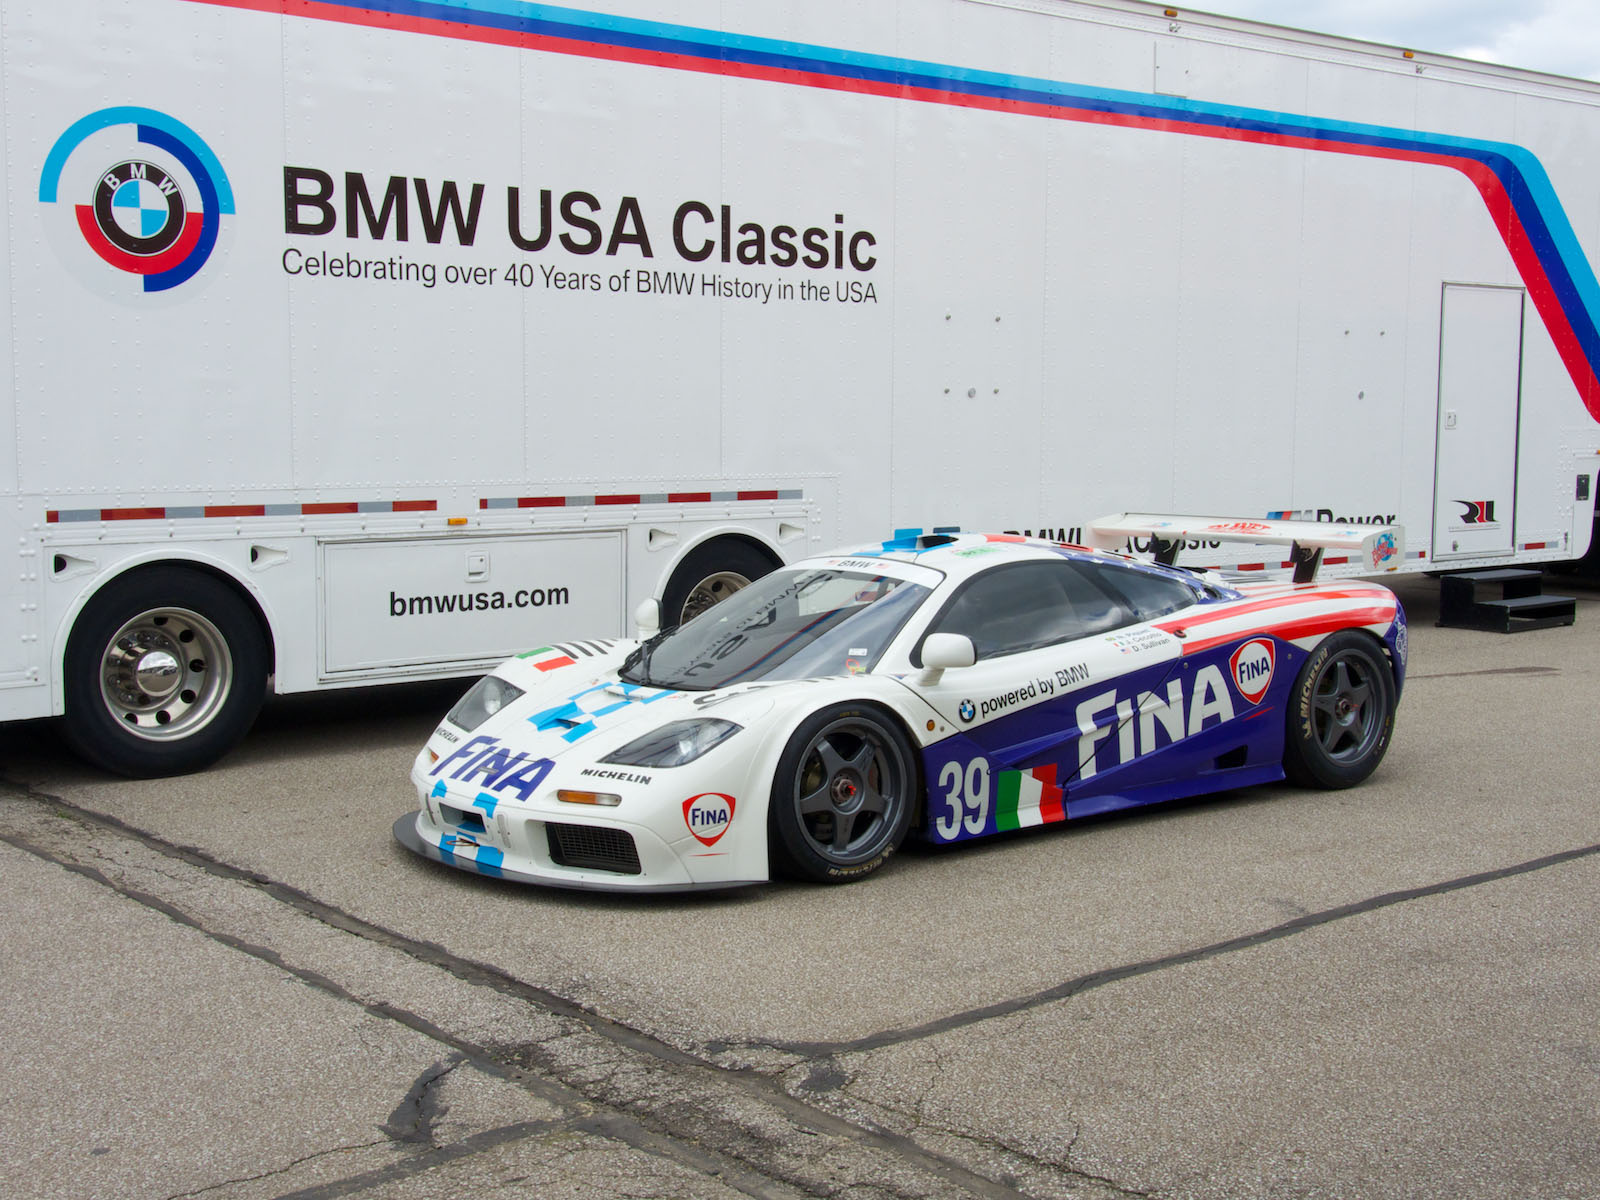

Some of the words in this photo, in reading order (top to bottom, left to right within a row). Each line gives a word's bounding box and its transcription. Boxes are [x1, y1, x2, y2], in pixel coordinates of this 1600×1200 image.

[103, 162, 178, 198] BMW
[283, 165, 485, 247] BMW
[507, 186, 654, 258] USA
[672, 200, 877, 272] Classic
[282, 248, 436, 288] Celebrating
[445, 265, 497, 285] over
[504, 263, 533, 287] 40
[540, 264, 601, 291] Years
[608, 269, 630, 292] of
[636, 270, 695, 295] BMW
[701, 274, 773, 304] History
[778, 278, 794, 300] in
[800, 279, 831, 302] the
[836, 281, 877, 303] USA
[390, 586, 569, 617] bmwusa.com
[980, 681, 1036, 718] powered
[1036, 678, 1054, 695] by
[1055, 662, 1090, 688] BMW
[1238, 656, 1271, 685] FINA
[1075, 663, 1236, 780] FINA
[428, 735, 557, 802] FINA
[580, 768, 652, 786] MICHELIN
[691, 807, 729, 827] FINA
[935, 756, 991, 841] 39
